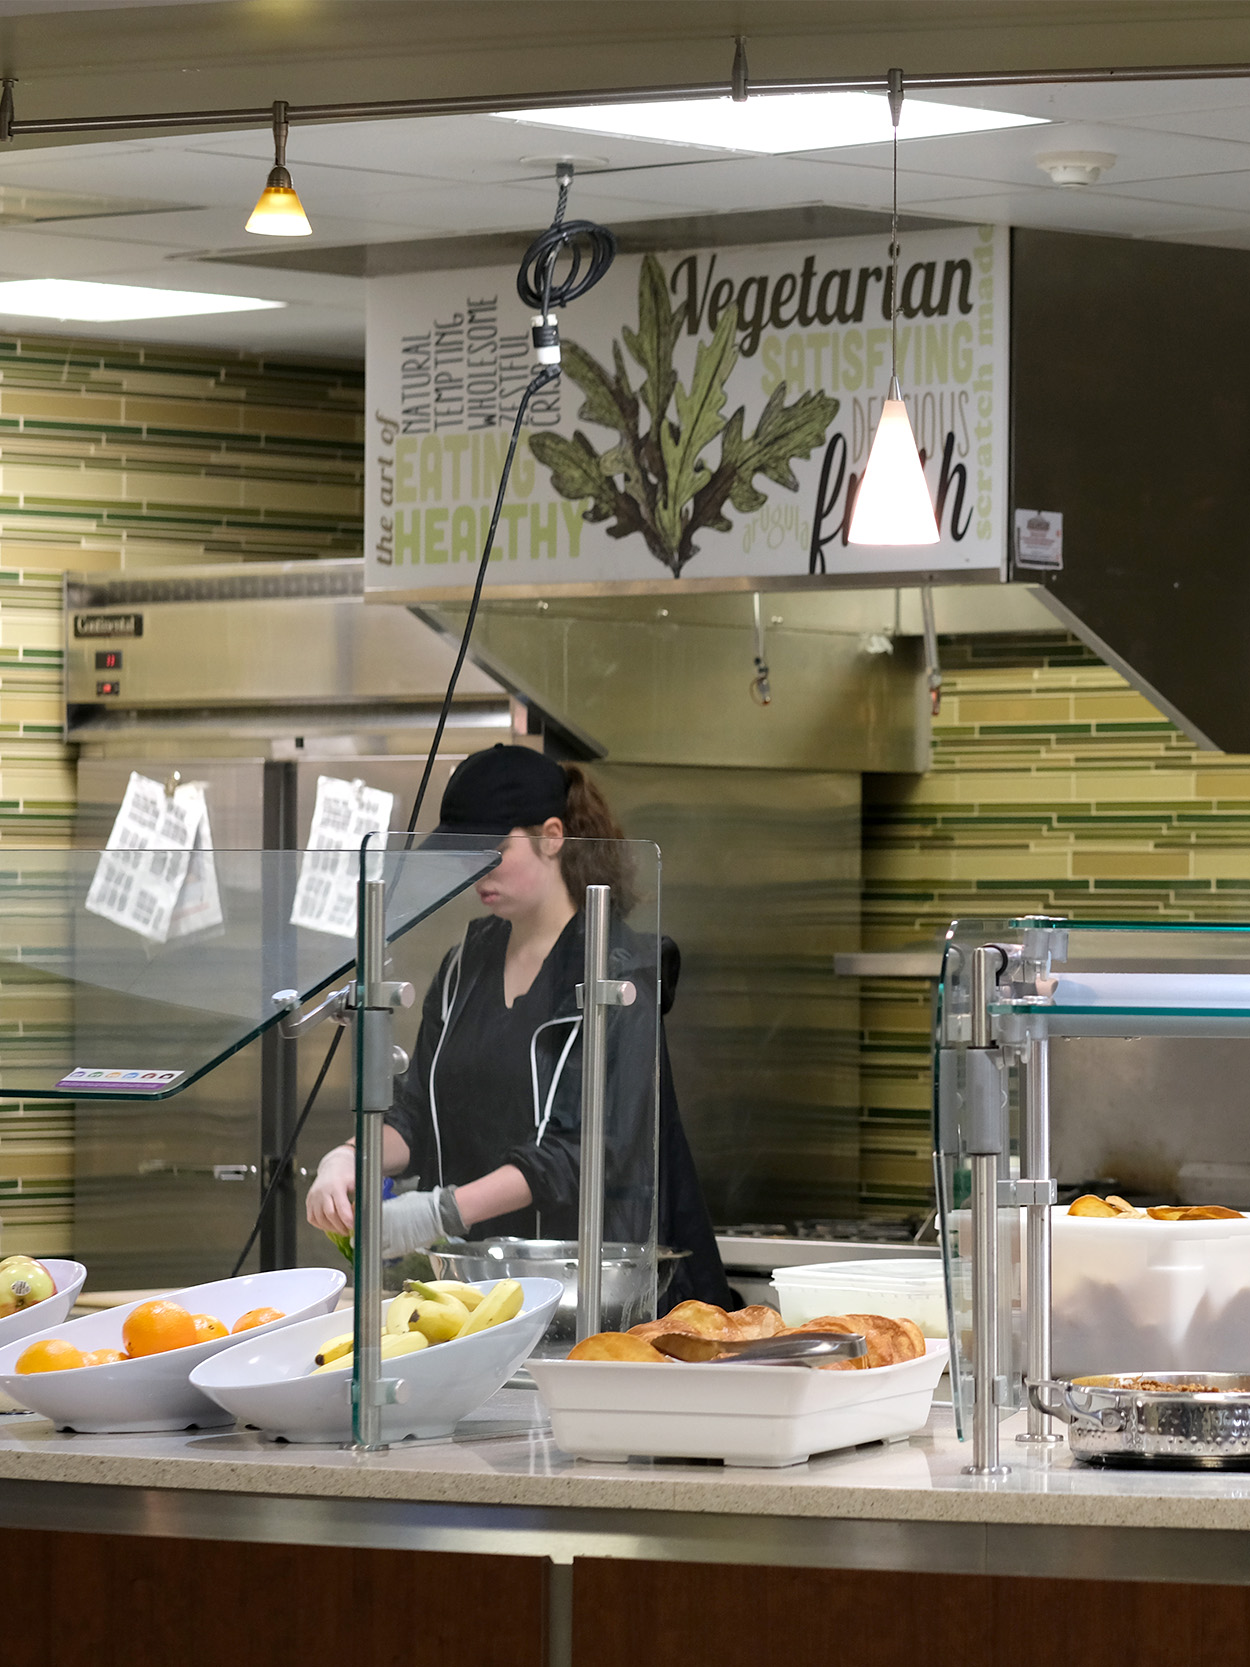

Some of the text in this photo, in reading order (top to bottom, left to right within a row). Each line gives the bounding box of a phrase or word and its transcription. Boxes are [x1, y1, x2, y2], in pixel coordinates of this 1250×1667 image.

[671, 253, 973, 358] Vegetarian
[401, 330, 431, 434] NATURAL
[434, 311, 465, 432] TEMPTING
[467, 294, 498, 430] WHOLESOME
[761, 320, 973, 396] SATISFYING
[375, 408, 399, 566] the art of
[395, 428, 536, 503] EATING
[973, 361, 993, 541] scratch
[395, 499, 589, 566] HEALTHY
[742, 504, 809, 554] arugula
